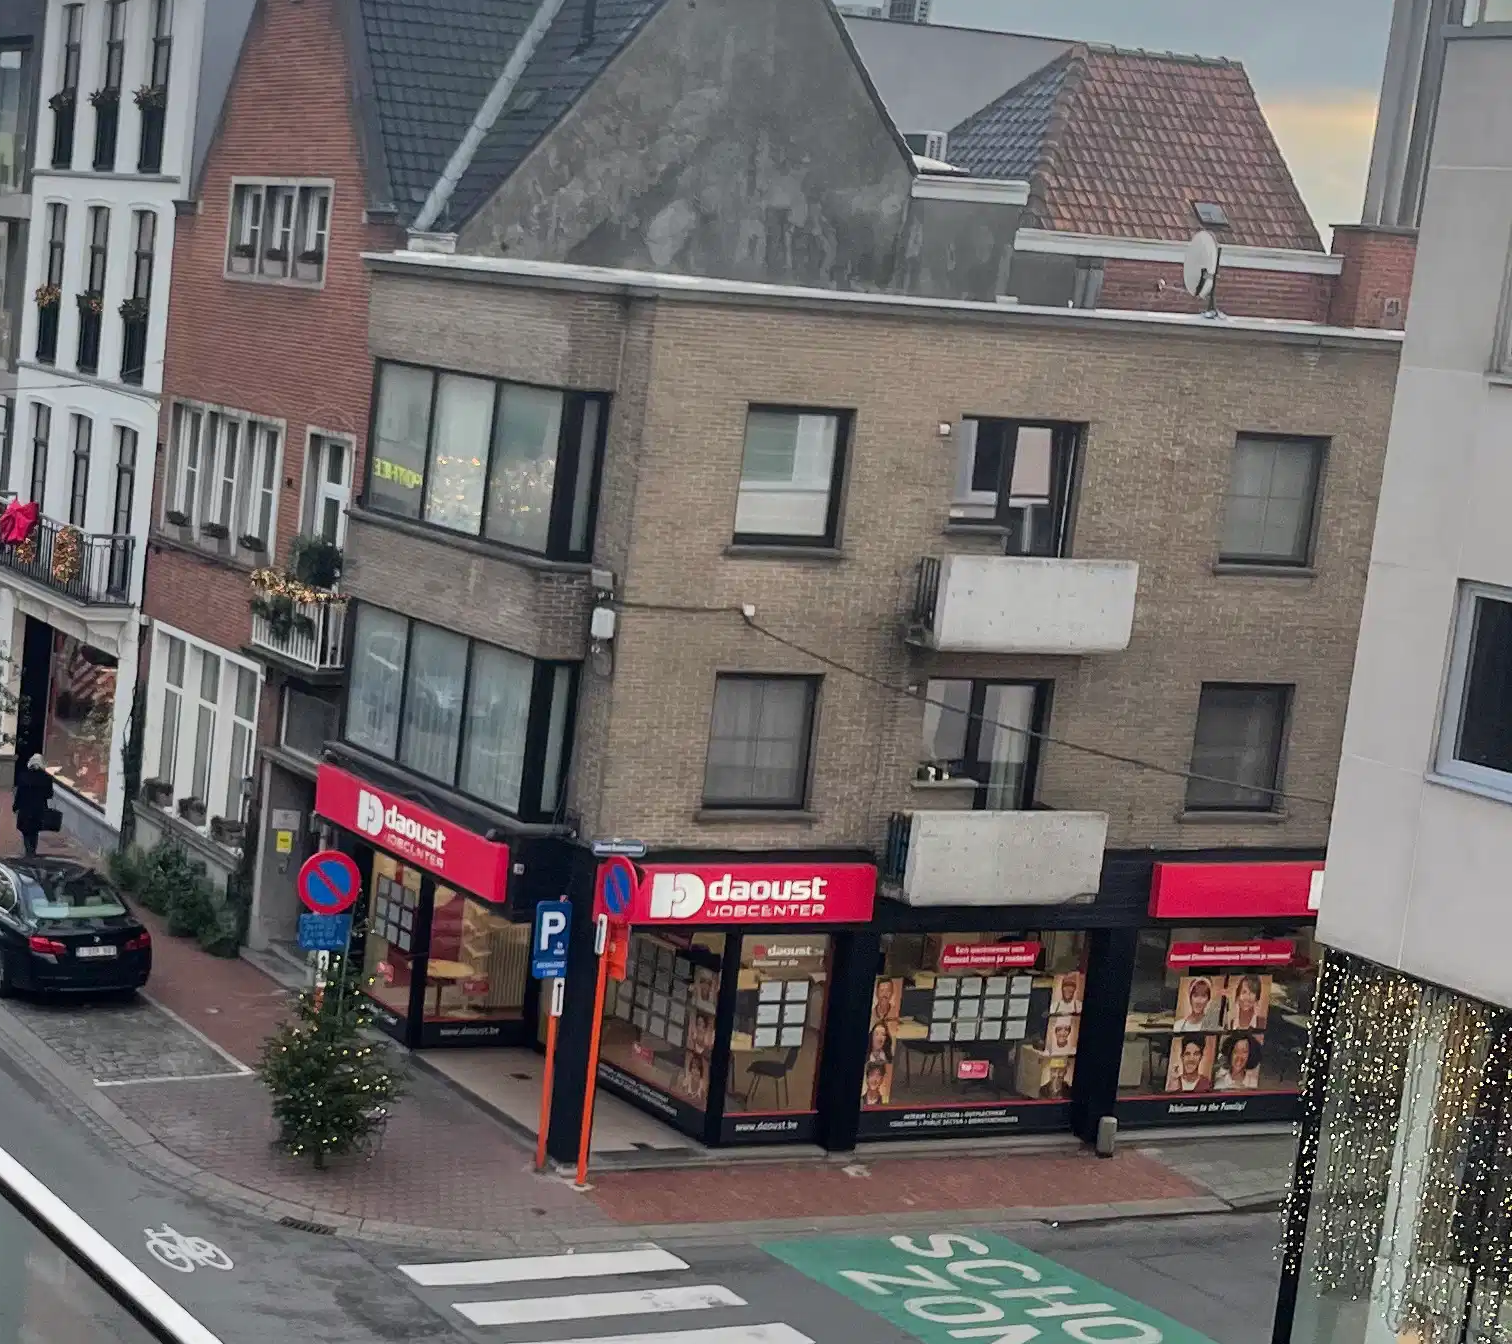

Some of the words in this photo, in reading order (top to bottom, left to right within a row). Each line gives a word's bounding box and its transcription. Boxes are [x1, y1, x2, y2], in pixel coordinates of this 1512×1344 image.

[385, 805, 446, 855] daoust
[384, 836, 445, 869] JOBCENTER
[708, 873, 828, 902] daoust
[706, 904, 826, 918] JOBCENTER
[540, 911, 566, 951] P
[767, 944, 812, 957] daoust
[735, 1121, 798, 1132] www.daoust.be
